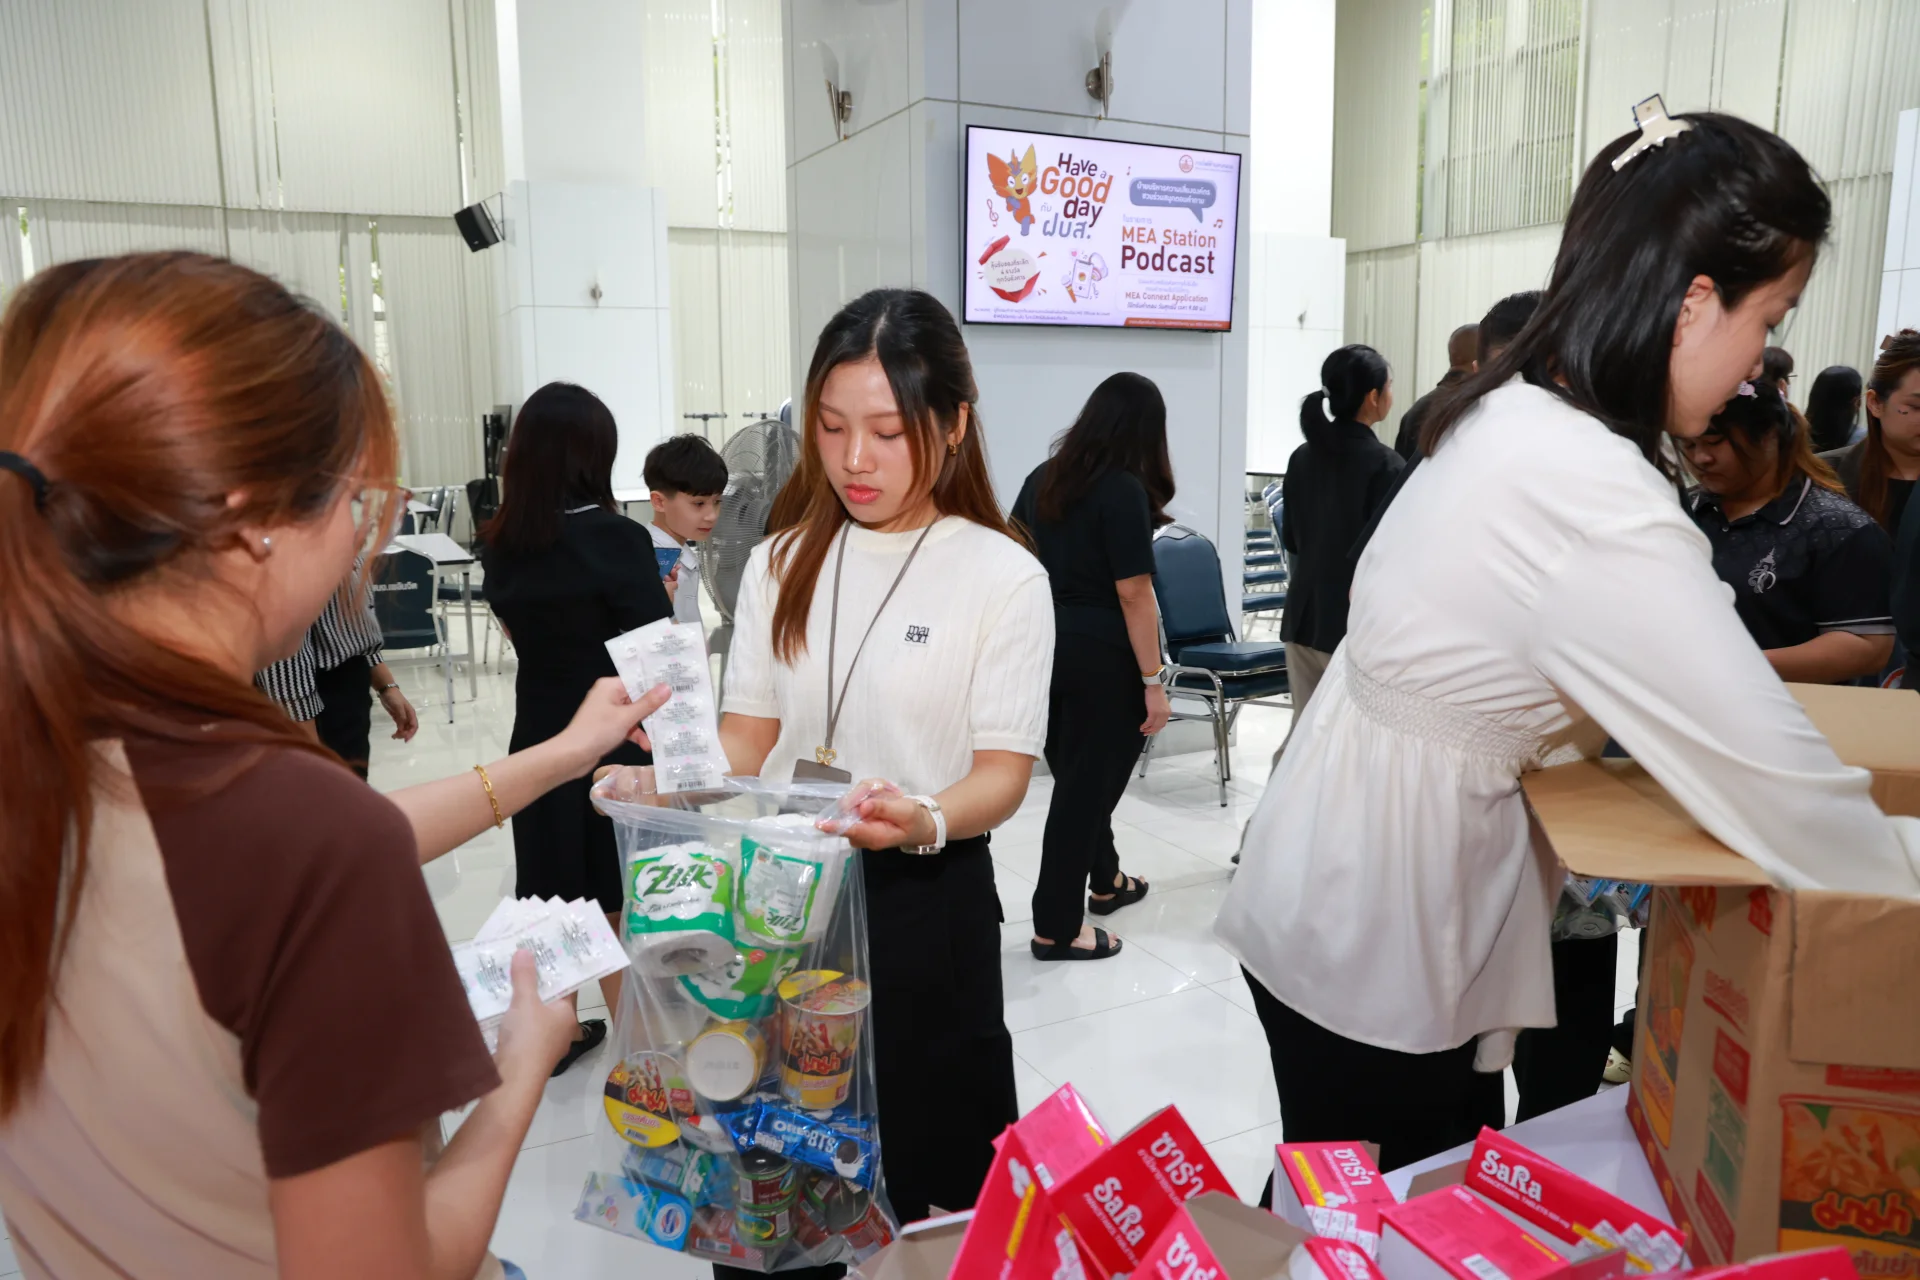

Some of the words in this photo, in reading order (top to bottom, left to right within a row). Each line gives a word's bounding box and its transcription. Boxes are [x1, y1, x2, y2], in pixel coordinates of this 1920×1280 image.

[1058, 152, 1098, 177] Have
[1099, 170, 1107, 179] a
[1040, 166, 1114, 204] Good
[1063, 196, 1103, 228] day
[1121, 225, 1157, 244] MEA
[1162, 228, 1217, 248] Station
[1121, 244, 1215, 274] Podcast
[1125, 291, 1141, 300] MEA
[1142, 292, 1170, 301] Connext
[1171, 293, 1209, 304] Application
[642, 863, 713, 897] Zilk
[808, 1129, 836, 1153] BTS
[1150, 1131, 1204, 1200] ซาร่า
[1333, 1148, 1377, 1186] ซาร่า
[1481, 1149, 1543, 1202] SaRa
[1477, 1172, 1520, 1200] PARACETAMOL
[1082, 1190, 1118, 1237] PARACETAMOL
[1092, 1177, 1146, 1247] SaRa
